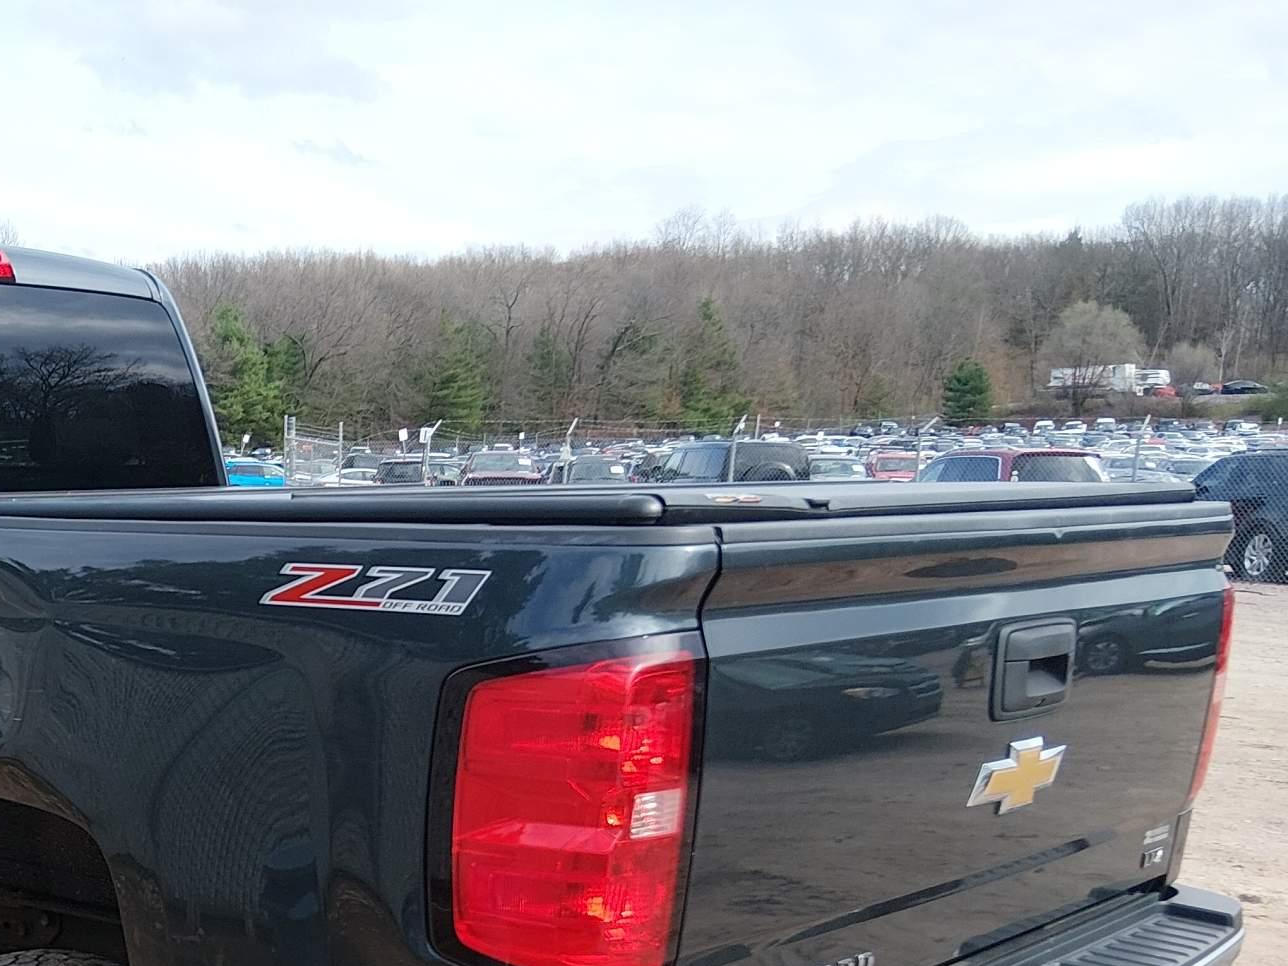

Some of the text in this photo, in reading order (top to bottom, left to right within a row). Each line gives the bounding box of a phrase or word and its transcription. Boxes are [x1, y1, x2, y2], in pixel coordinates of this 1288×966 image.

[259, 562, 492, 612] Z71
[382, 600, 462, 614] OFF ROAD
